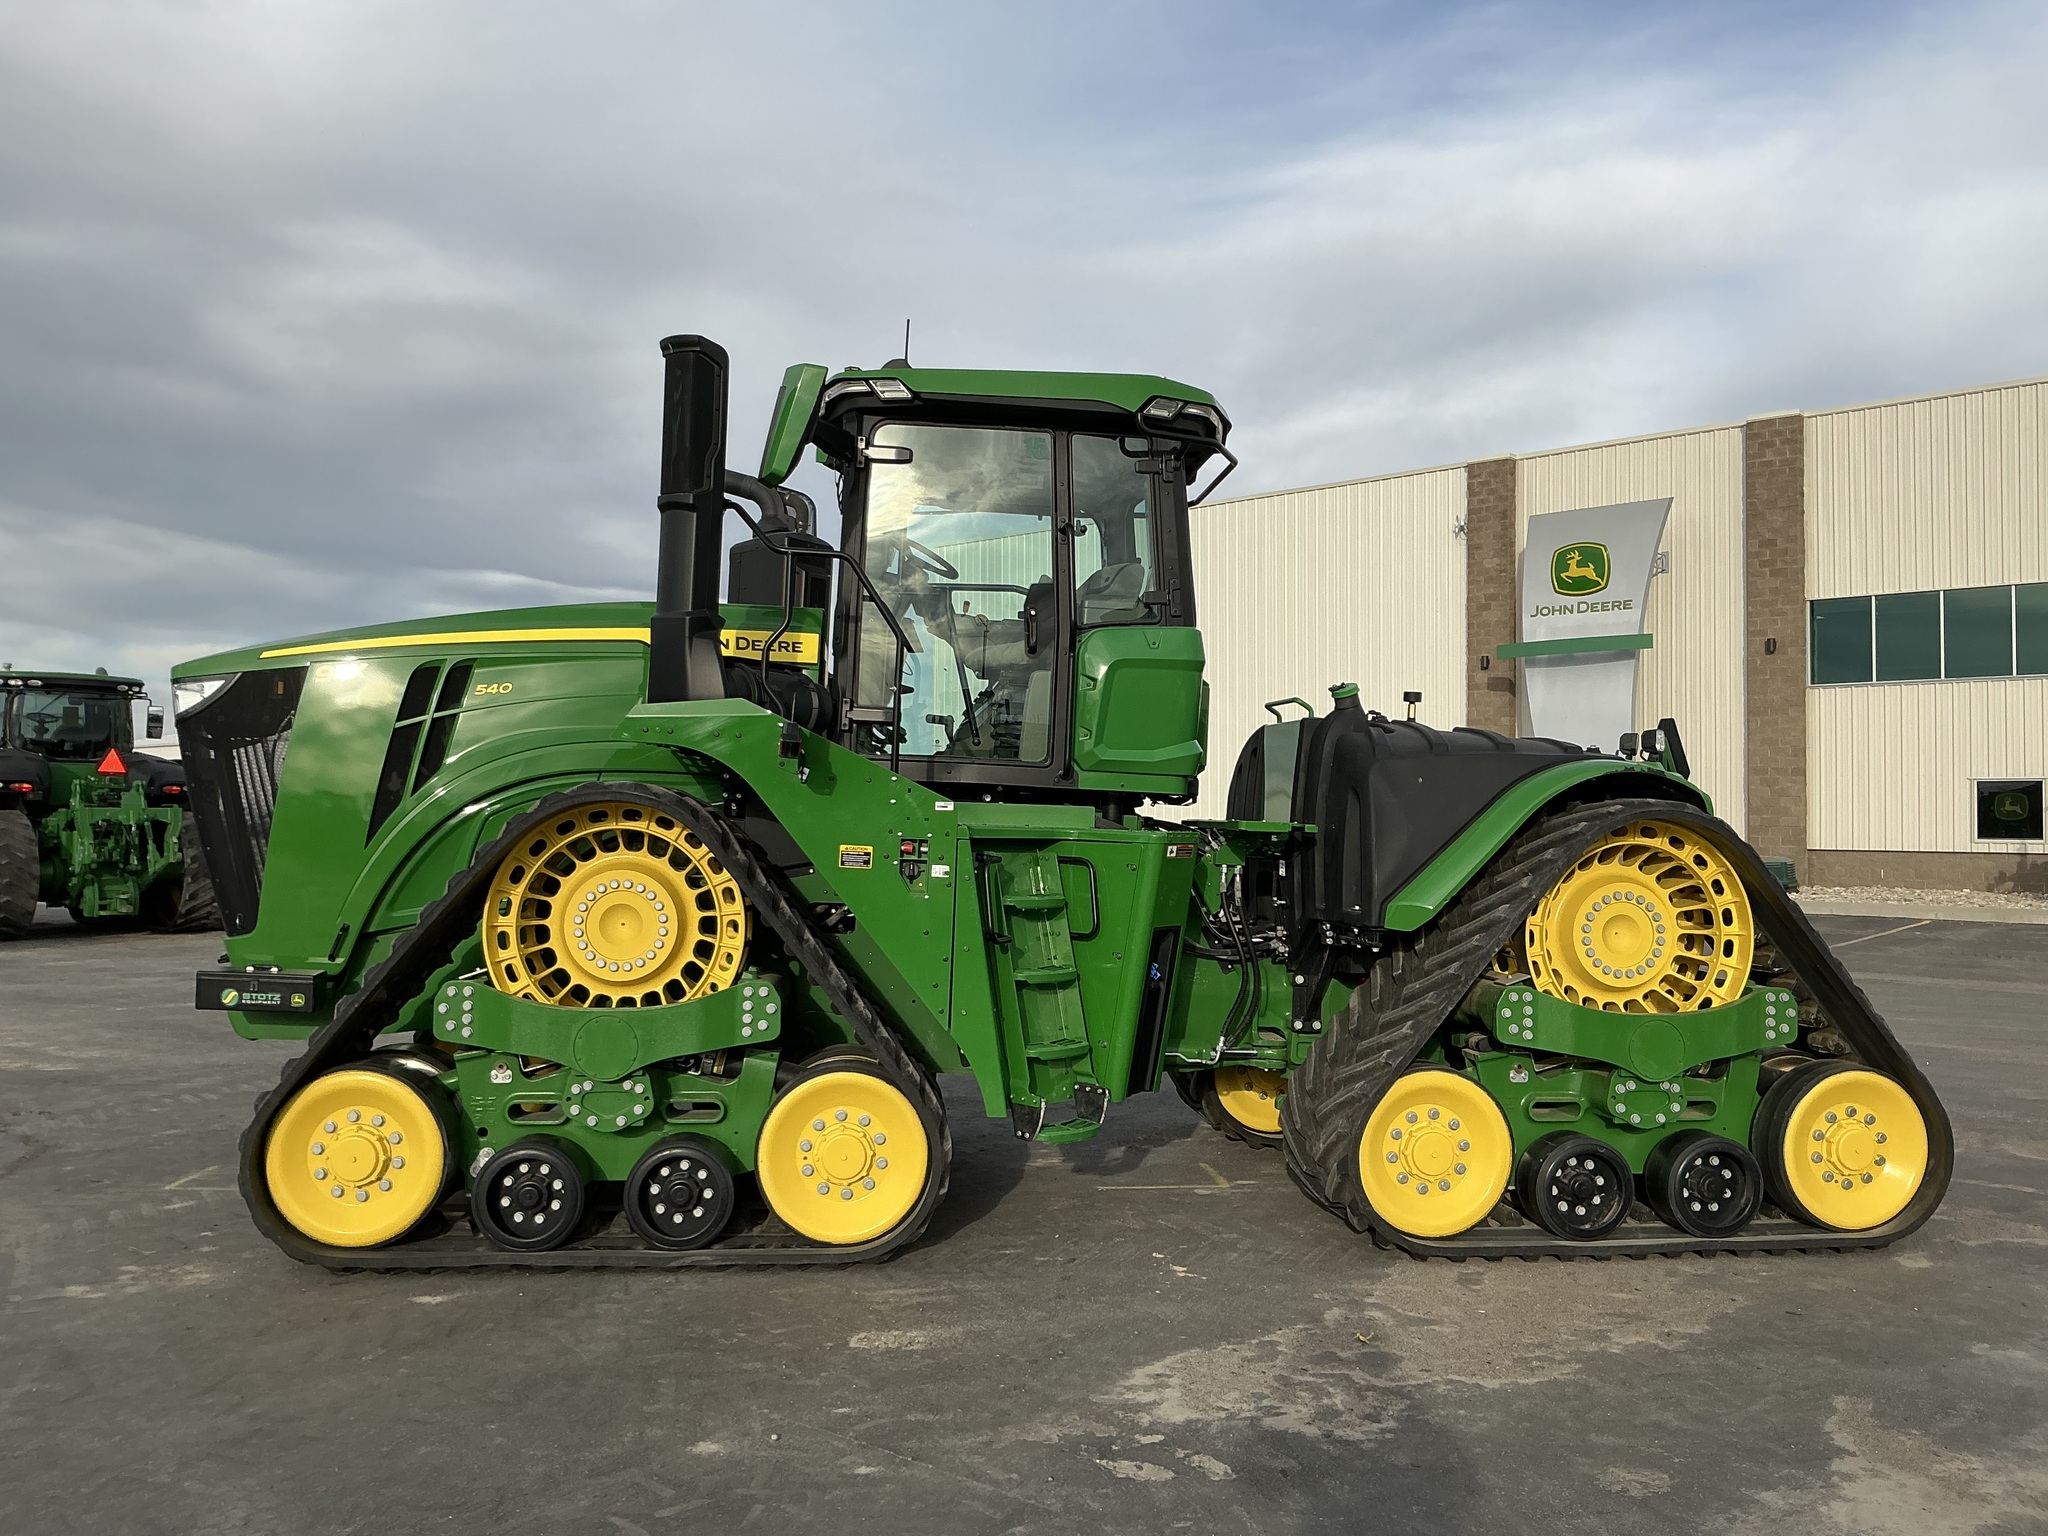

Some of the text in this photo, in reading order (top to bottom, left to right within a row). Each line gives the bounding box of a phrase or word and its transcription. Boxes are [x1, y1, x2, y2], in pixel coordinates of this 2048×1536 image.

[1530, 599, 1633, 618] JOHN DEERE
[474, 682, 513, 696] 540
[242, 992, 281, 1000] STOTZ
